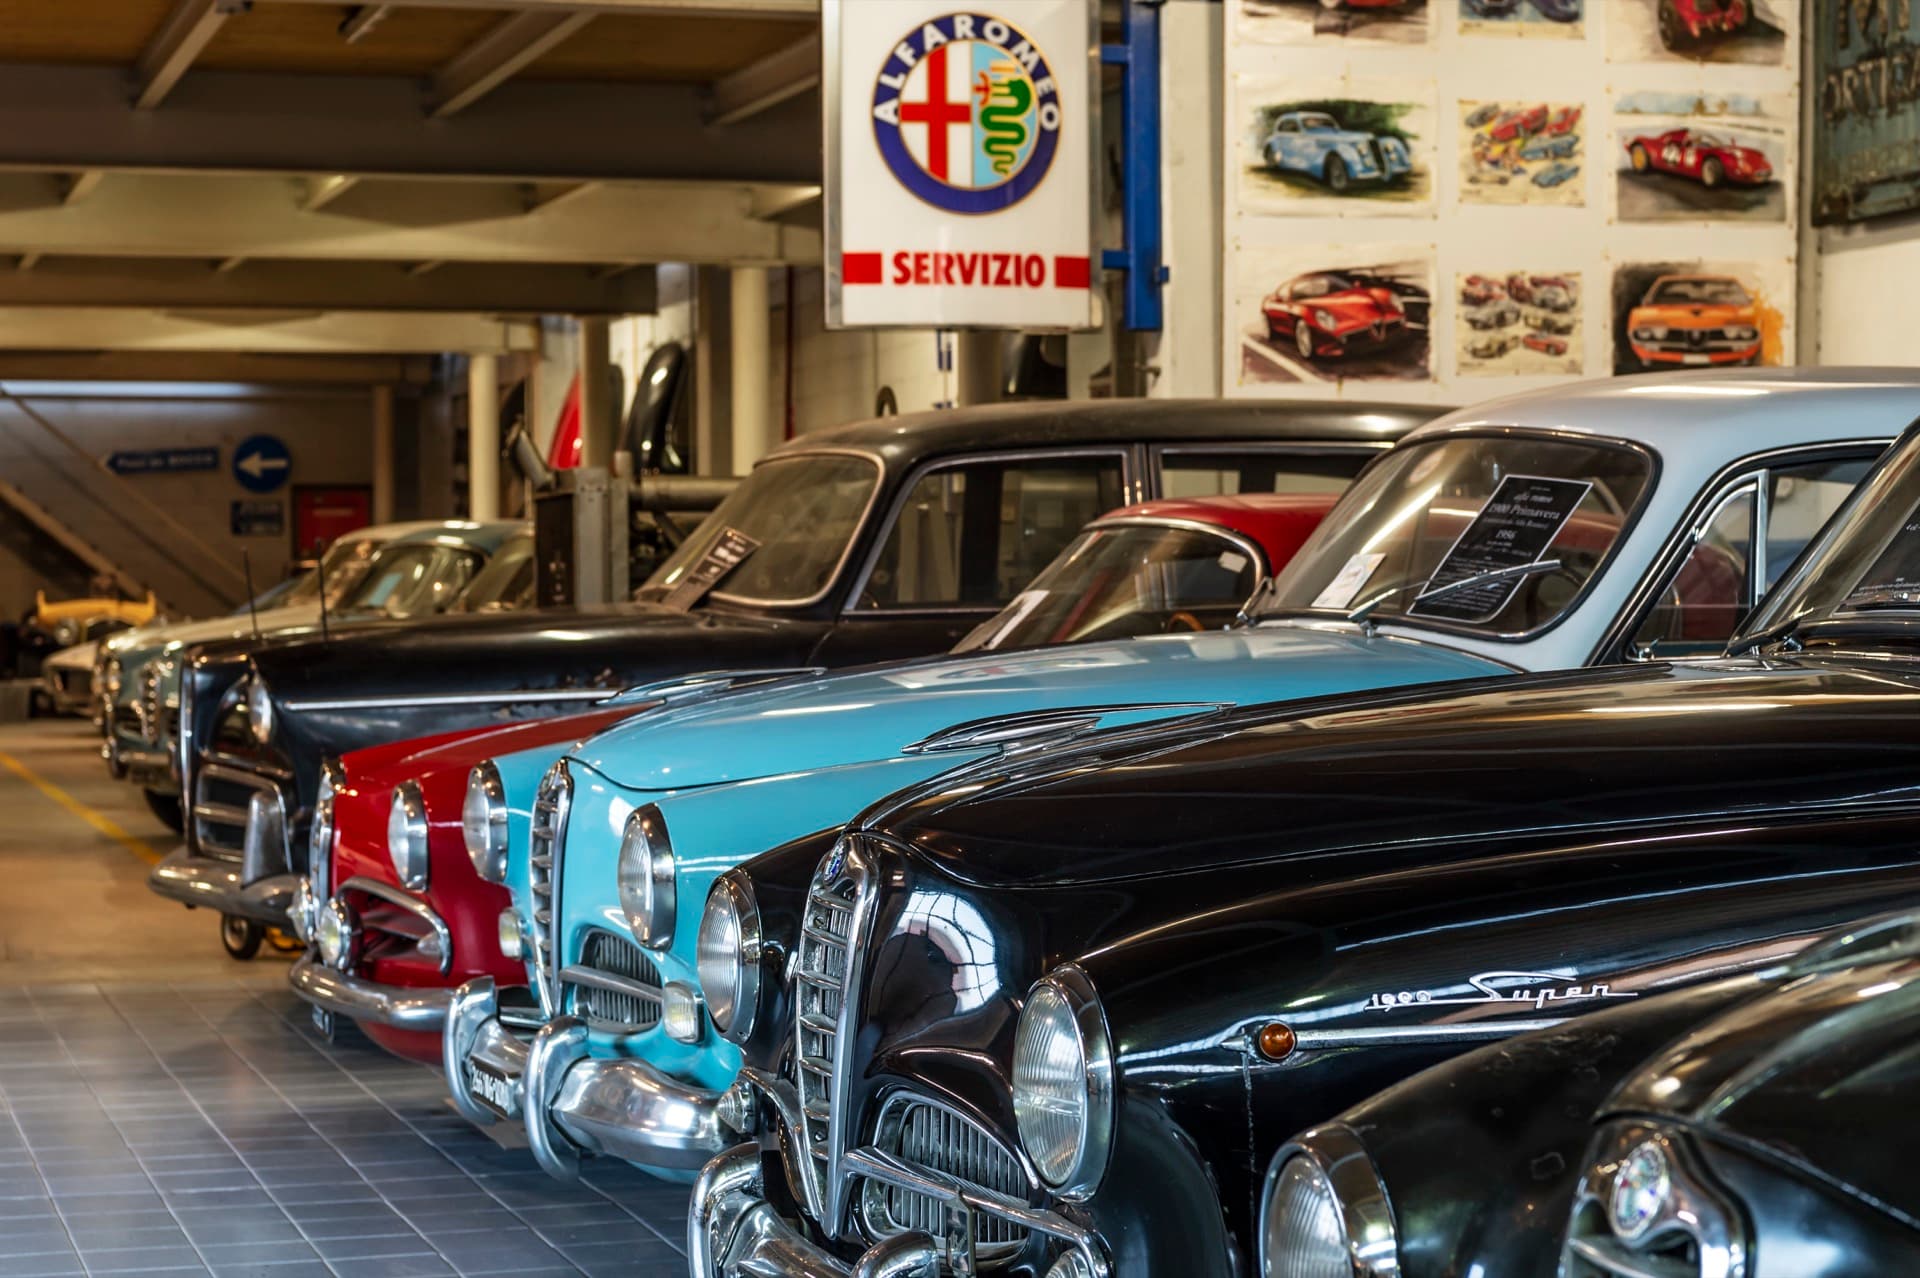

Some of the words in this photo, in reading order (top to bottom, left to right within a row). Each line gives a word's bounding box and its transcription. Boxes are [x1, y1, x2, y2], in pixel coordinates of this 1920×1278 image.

[892, 251, 1046, 288] SERVIZIO
[1365, 990, 1432, 1011] 1900
[1468, 970, 1638, 1010] Super
